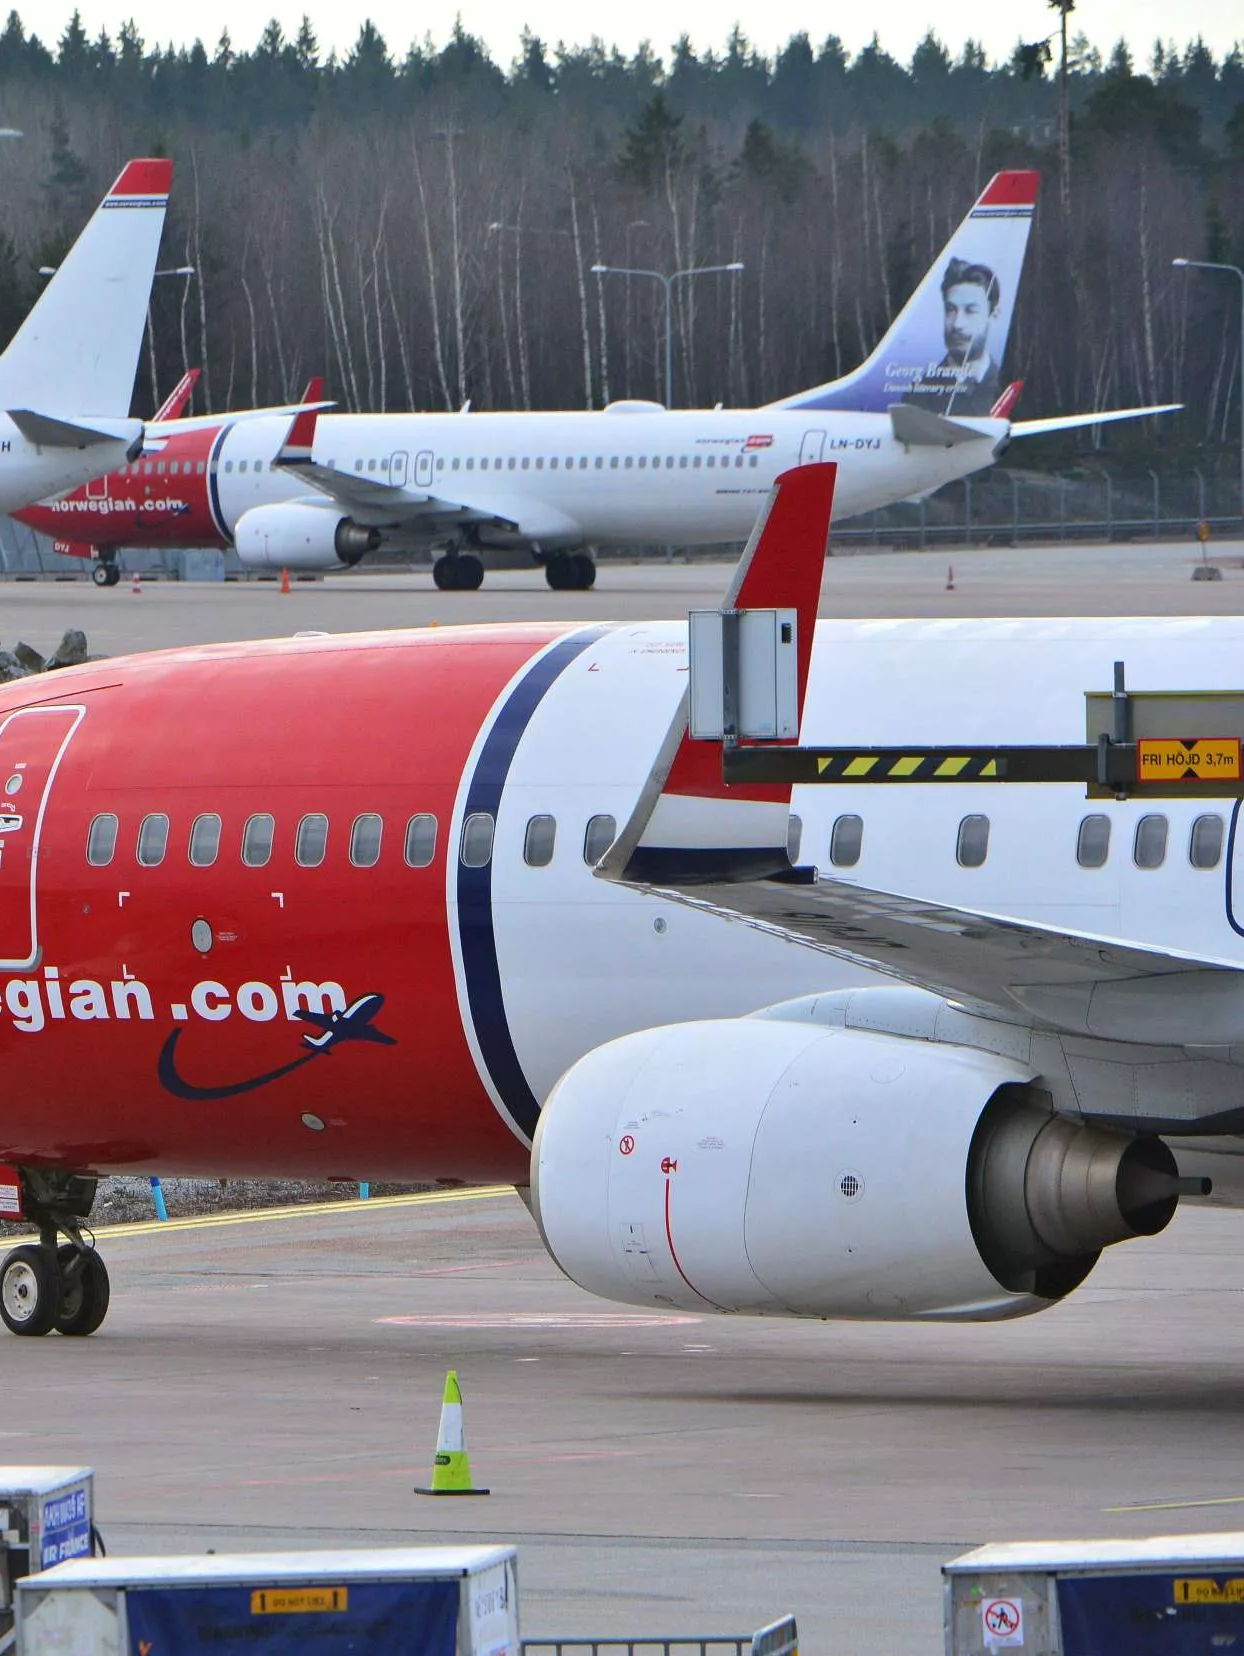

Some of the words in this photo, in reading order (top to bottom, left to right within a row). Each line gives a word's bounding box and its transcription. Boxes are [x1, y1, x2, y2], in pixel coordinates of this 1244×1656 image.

[885, 360, 924, 382] Georg
[830, 438, 880, 449] LN-DYJ
[52, 498, 136, 514] norwegian
[1142, 753, 1162, 766] FRI
[1166, 752, 1201, 766] HÖJD
[1205, 753, 1234, 767] 3,7m
[171, 980, 348, 1022] .com
[59, 1532, 89, 1560] FRANCE
